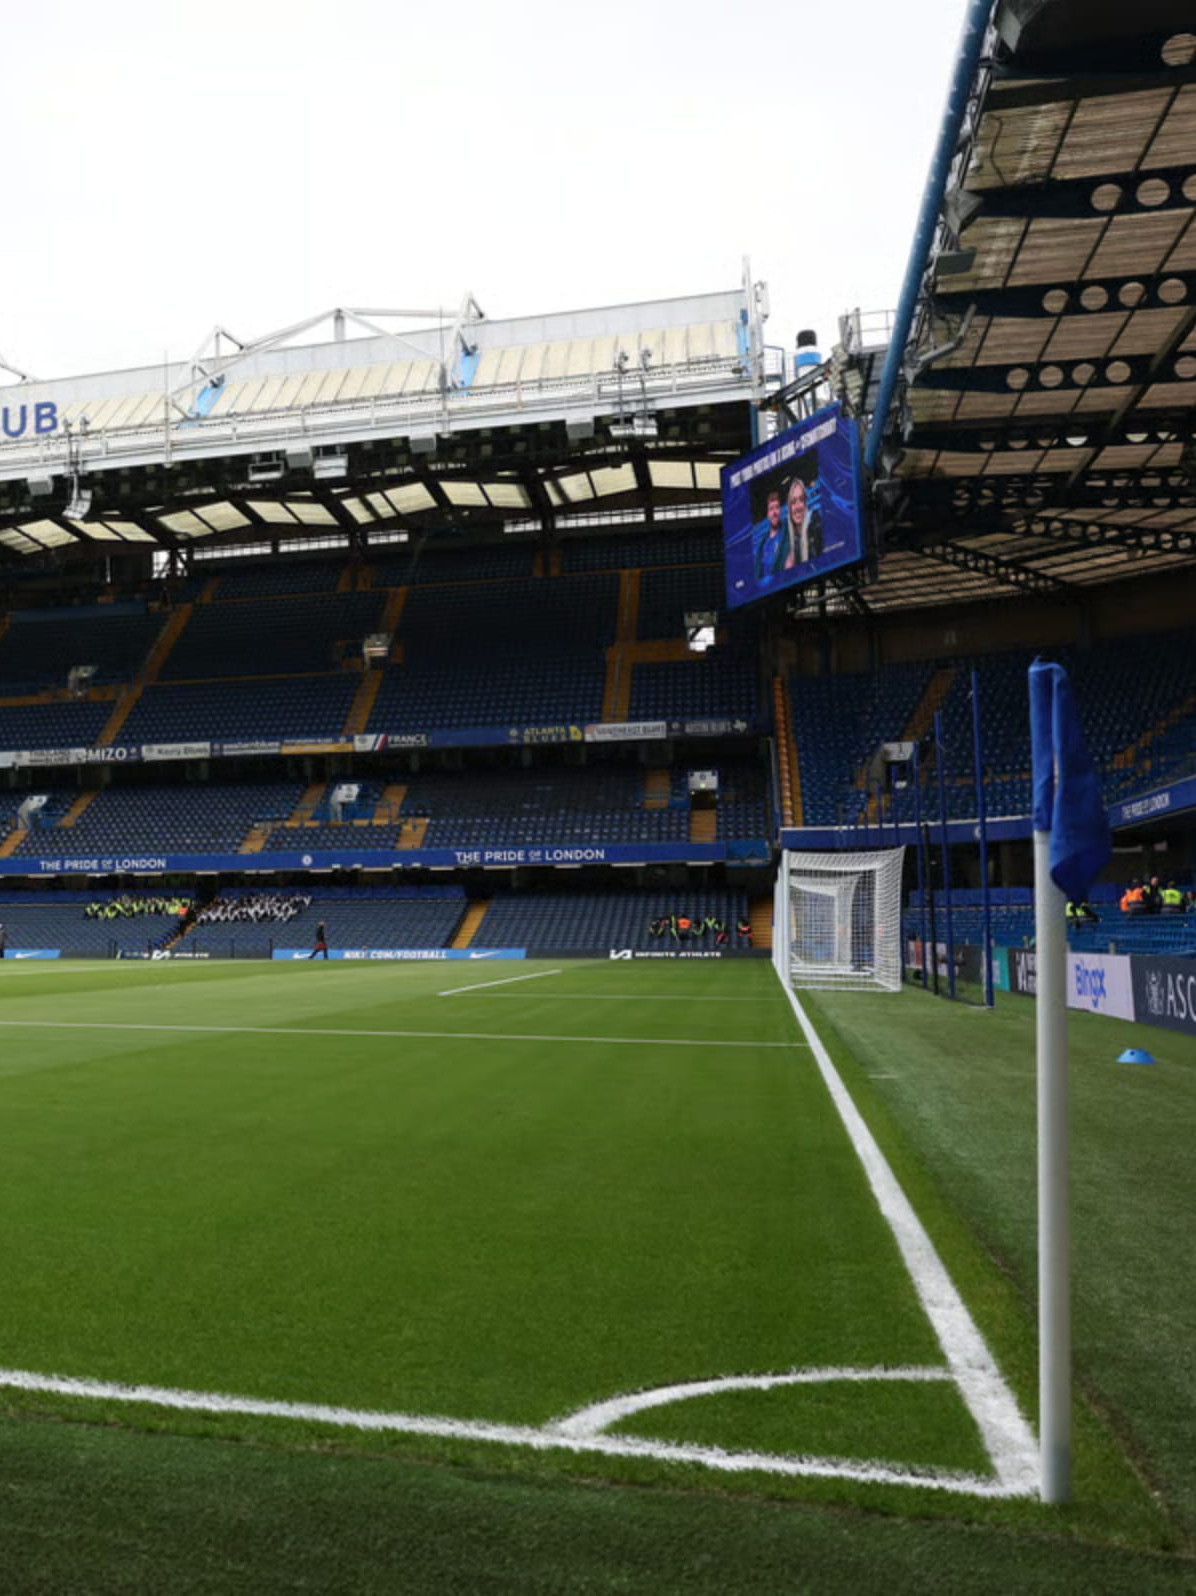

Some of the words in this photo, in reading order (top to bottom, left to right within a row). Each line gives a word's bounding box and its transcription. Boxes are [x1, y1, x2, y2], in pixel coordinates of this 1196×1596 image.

[524, 727, 565, 735] ATLANTA
[387, 734, 426, 744] FRANCE
[524, 734, 566, 742] BLUES
[88, 747, 127, 761] MIZO
[455, 852, 481, 863] THE
[484, 850, 524, 862] PRIDE
[528, 850, 542, 861] OF
[545, 849, 605, 861] LONDON
[40, 860, 61, 870] THE
[64, 860, 98, 869] PRIDE
[101, 860, 113, 869] OF
[115, 858, 167, 869] LONDON
